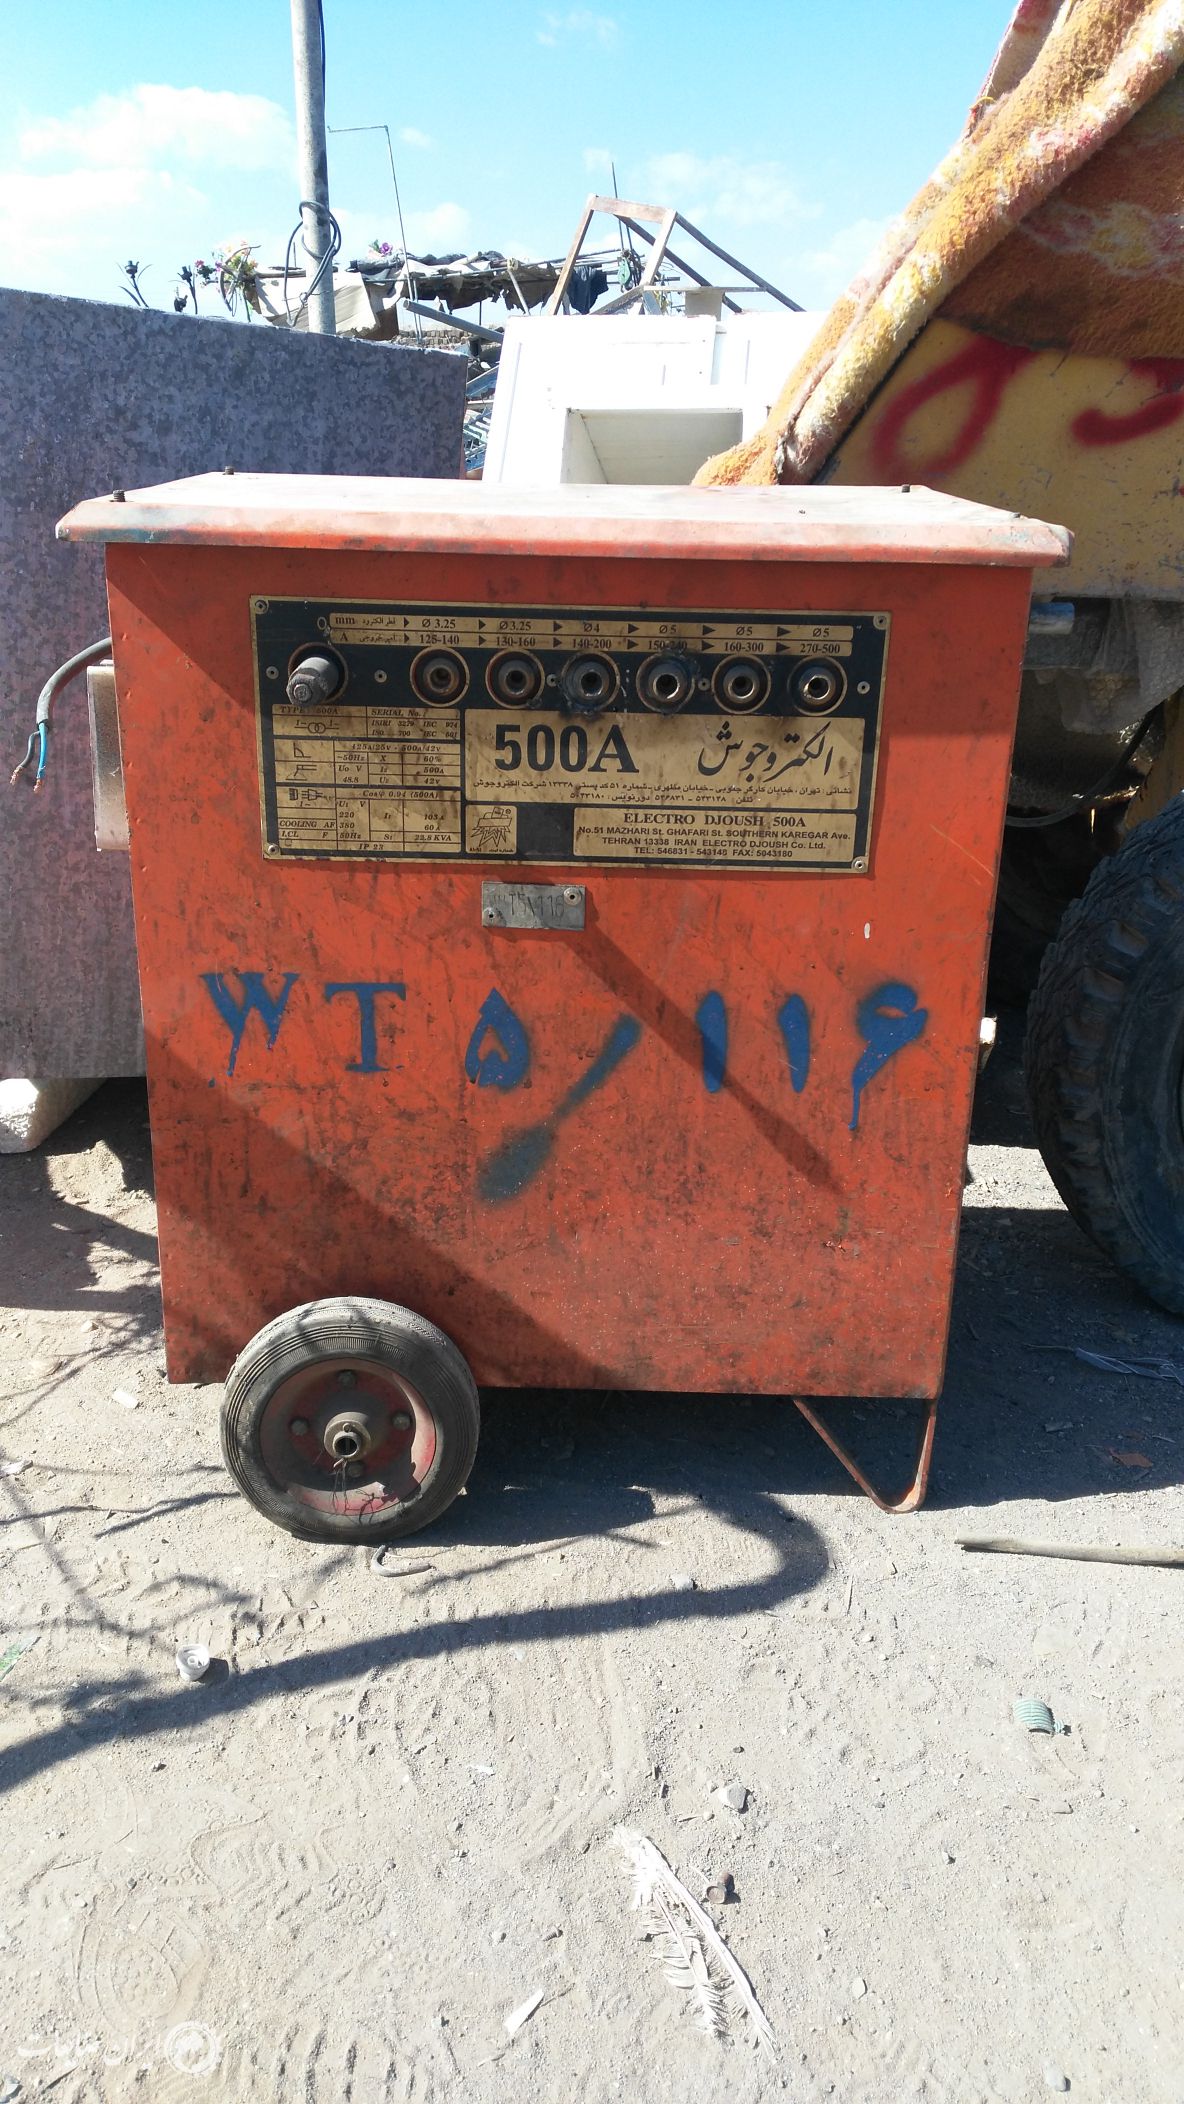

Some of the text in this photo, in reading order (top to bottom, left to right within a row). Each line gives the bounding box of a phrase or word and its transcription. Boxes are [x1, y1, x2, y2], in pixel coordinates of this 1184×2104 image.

[335, 616, 355, 625] mm
[434, 619, 456, 628] 3.25
[340, 631, 348, 641] A
[419, 633, 460, 645] 125-140
[496, 636, 536, 647] 130-160
[572, 638, 611, 648] 140-200
[724, 641, 764, 652] 160-300
[800, 643, 840, 654] 270-500
[494, 723, 640, 774] 500A
[380, 754, 387, 762] X
[521, 780, 547, 789] شرکت
[682, 784, 708, 793] خیابان
[623, 812, 806, 828] ELECTRO DJOUSH 500A
[578, 826, 604, 834] No.51
[606, 826, 650, 835] MAZHARI
[666, 828, 709, 837] GHAFARI
[726, 830, 779, 838] SOUTHERN
[780, 831, 829, 839] KAREGAR
[830, 832, 851, 840] Ave.
[602, 837, 641, 845] TEHRAN
[644, 838, 669, 846] 13338
[702, 840, 747, 848] ELECTRO
[749, 841, 789, 849] DJOUSH
[790, 841, 805, 849] Co.
[634, 846, 654, 854] TEL:
